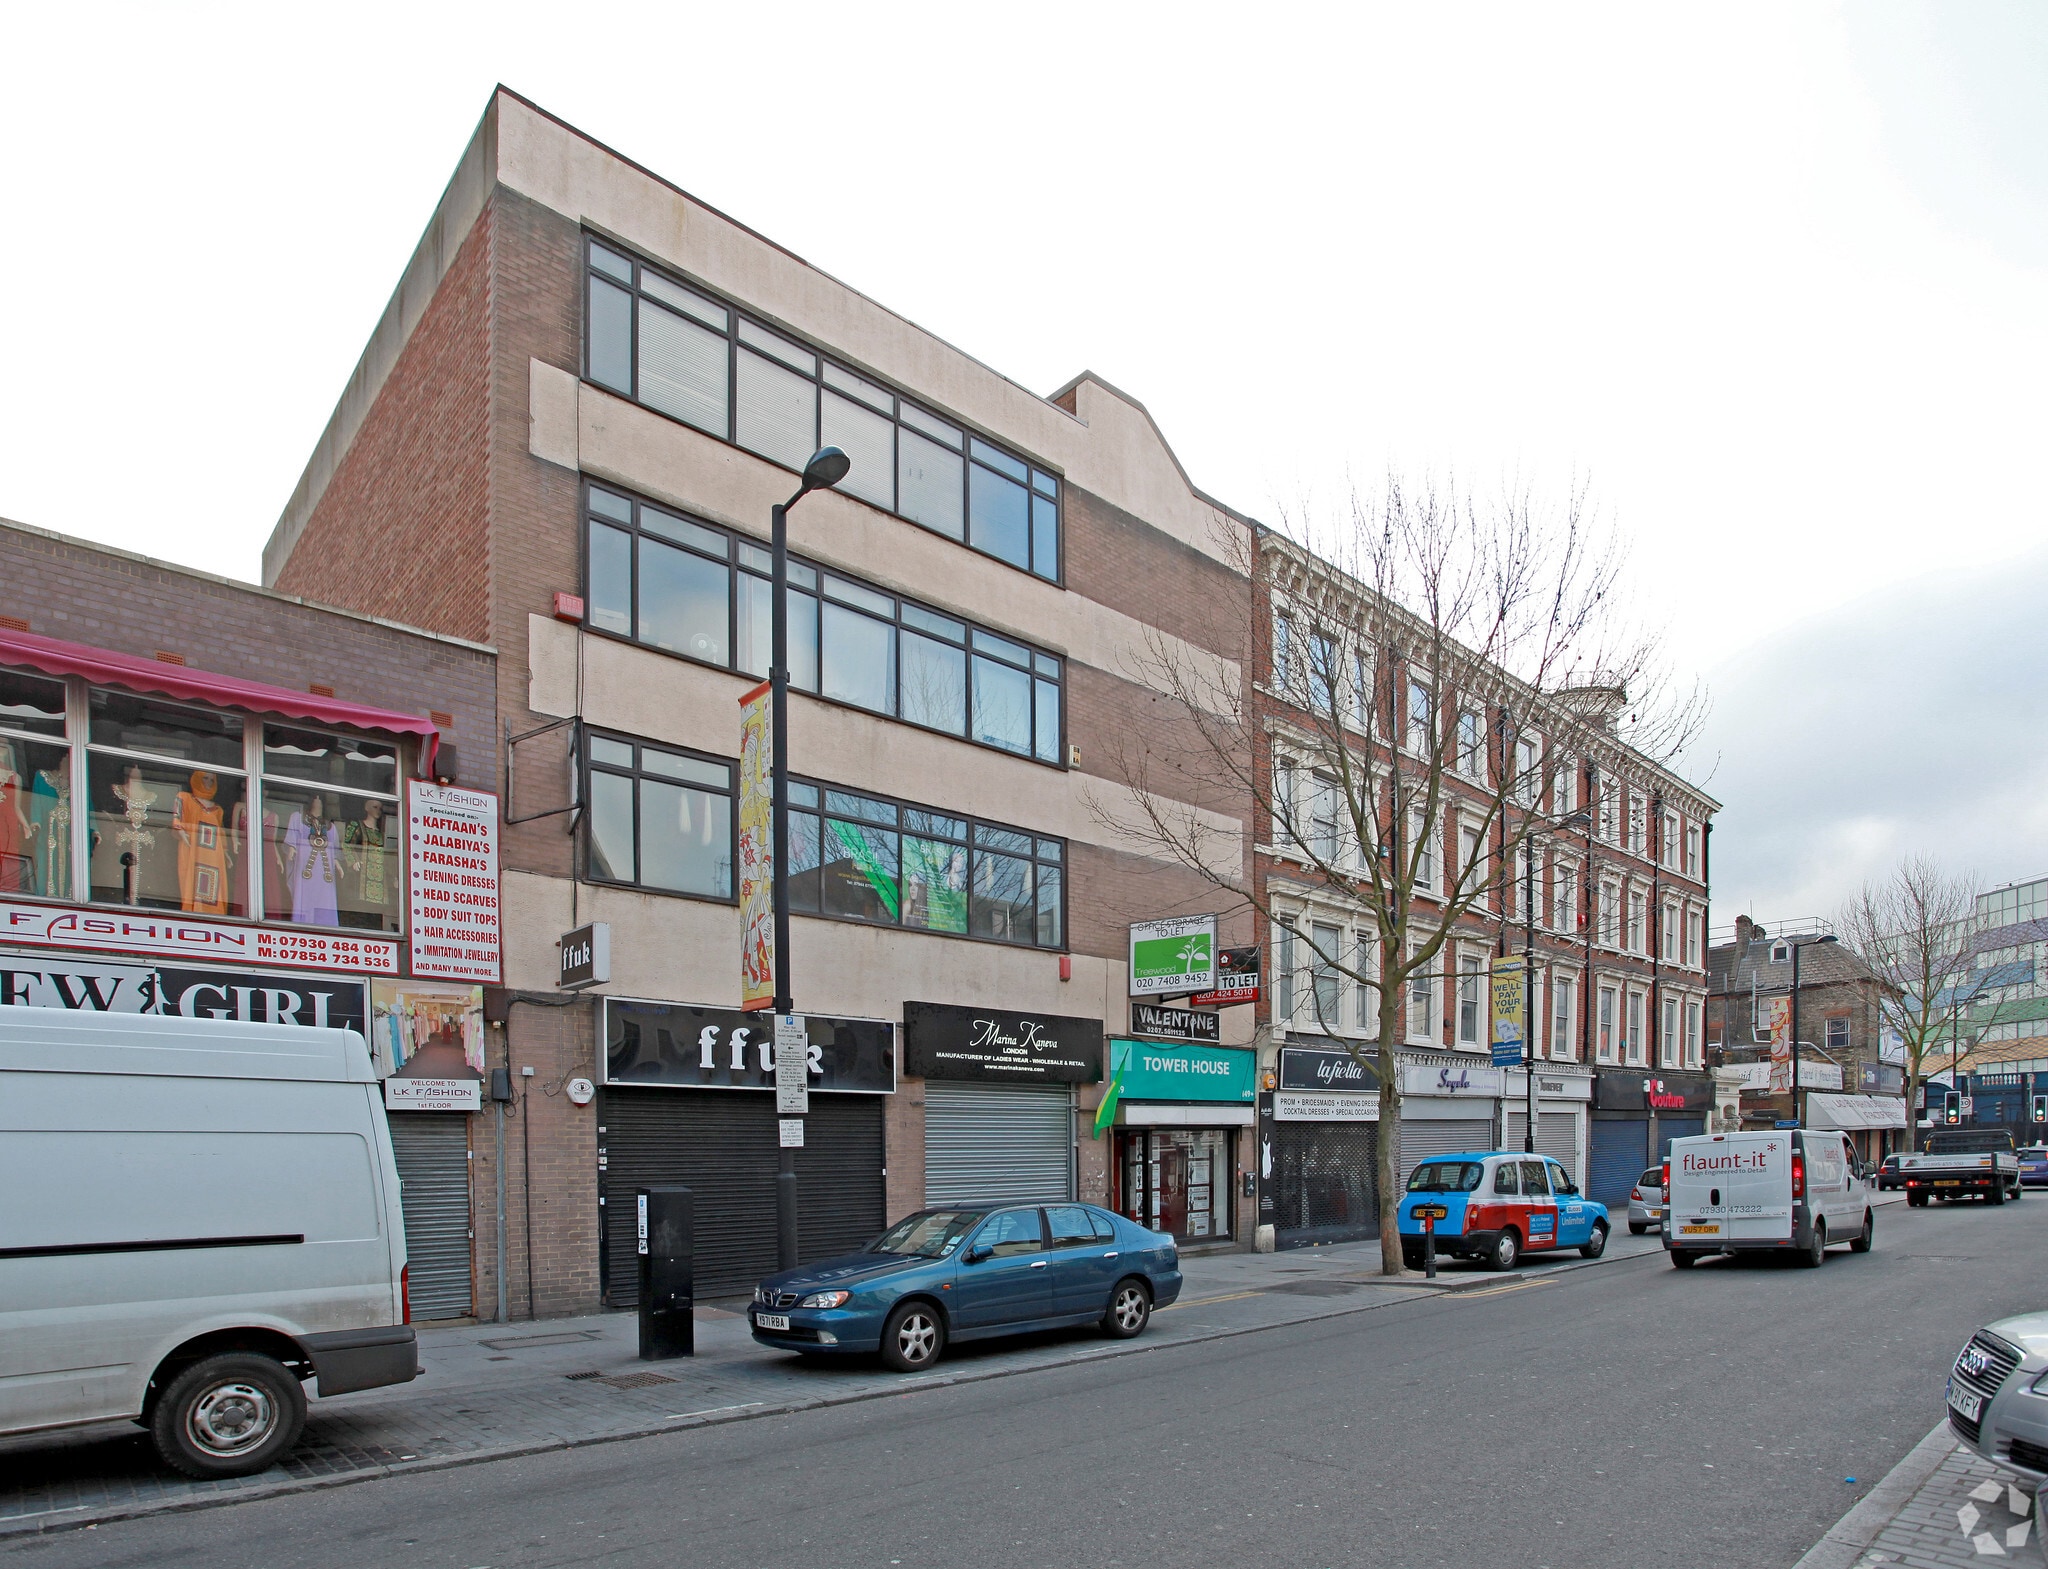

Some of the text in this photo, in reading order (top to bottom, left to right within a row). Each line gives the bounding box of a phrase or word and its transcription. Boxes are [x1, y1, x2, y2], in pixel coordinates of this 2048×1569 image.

[419, 788, 488, 808] LK FASHION
[429, 807, 465, 818] Specialised
[423, 815, 487, 836] KAFTAAN'S
[423, 834, 490, 854] JALABIYA'S
[423, 851, 487, 871] FARASHA'S
[423, 869, 496, 890] EVENING DRESSES
[423, 888, 497, 908] HEAD SCARVES
[423, 906, 497, 926] BODY SUIT TOPS
[1167, 916, 1205, 927] STORAGE
[10, 912, 245, 946] FASHION
[424, 926, 498, 944] HAIR ACCESSORIES
[1155, 926, 1185, 938] TO LET
[257, 933, 390, 955] M: 07930 484 007
[257, 947, 391, 968] M: 07854 734 536
[424, 945, 498, 963] IMMITATION JEWELLERY
[562, 940, 591, 971] ffuk
[415, 962, 430, 970] AND
[431, 963, 452, 973] MANY
[453, 966, 473, 975] MANY
[1135, 965, 1177, 976] Treewood
[1136, 972, 1208, 988] 020 7408 9452
[1221, 975, 1257, 988] TO LET
[0, 969, 350, 1030] EW GIRL
[1216, 990, 1232, 998] 424
[1233, 988, 1253, 996] 5010
[1498, 991, 1517, 1000] PAY
[1494, 998, 1521, 1007] YOUR
[1498, 1006, 1516, 1015] VAT
[969, 1019, 1059, 1052] Marina Kaneva
[1002, 1047, 1028, 1055] LONDON
[936, 1051, 984, 1061] MANUFACTURER
[1032, 1058, 1064, 1066] WHOLESALE
[1143, 1056, 1230, 1075] TOWER HOUSE
[984, 1064, 1045, 1072] www.marinakaneva.com
[393, 1087, 472, 1101] LK FASHION
[1280, 1097, 1380, 1107] PROM BRIDESMAIDS EVENING DRESSE
[1283, 1107, 1380, 1116] COCKTAIL DRESSES SPECIAL OCCASIONS
[1704, 1168, 1739, 1176] Engineered
[1699, 1205, 1762, 1214] 07930 473222
[771, 1316, 785, 1328] RBA
